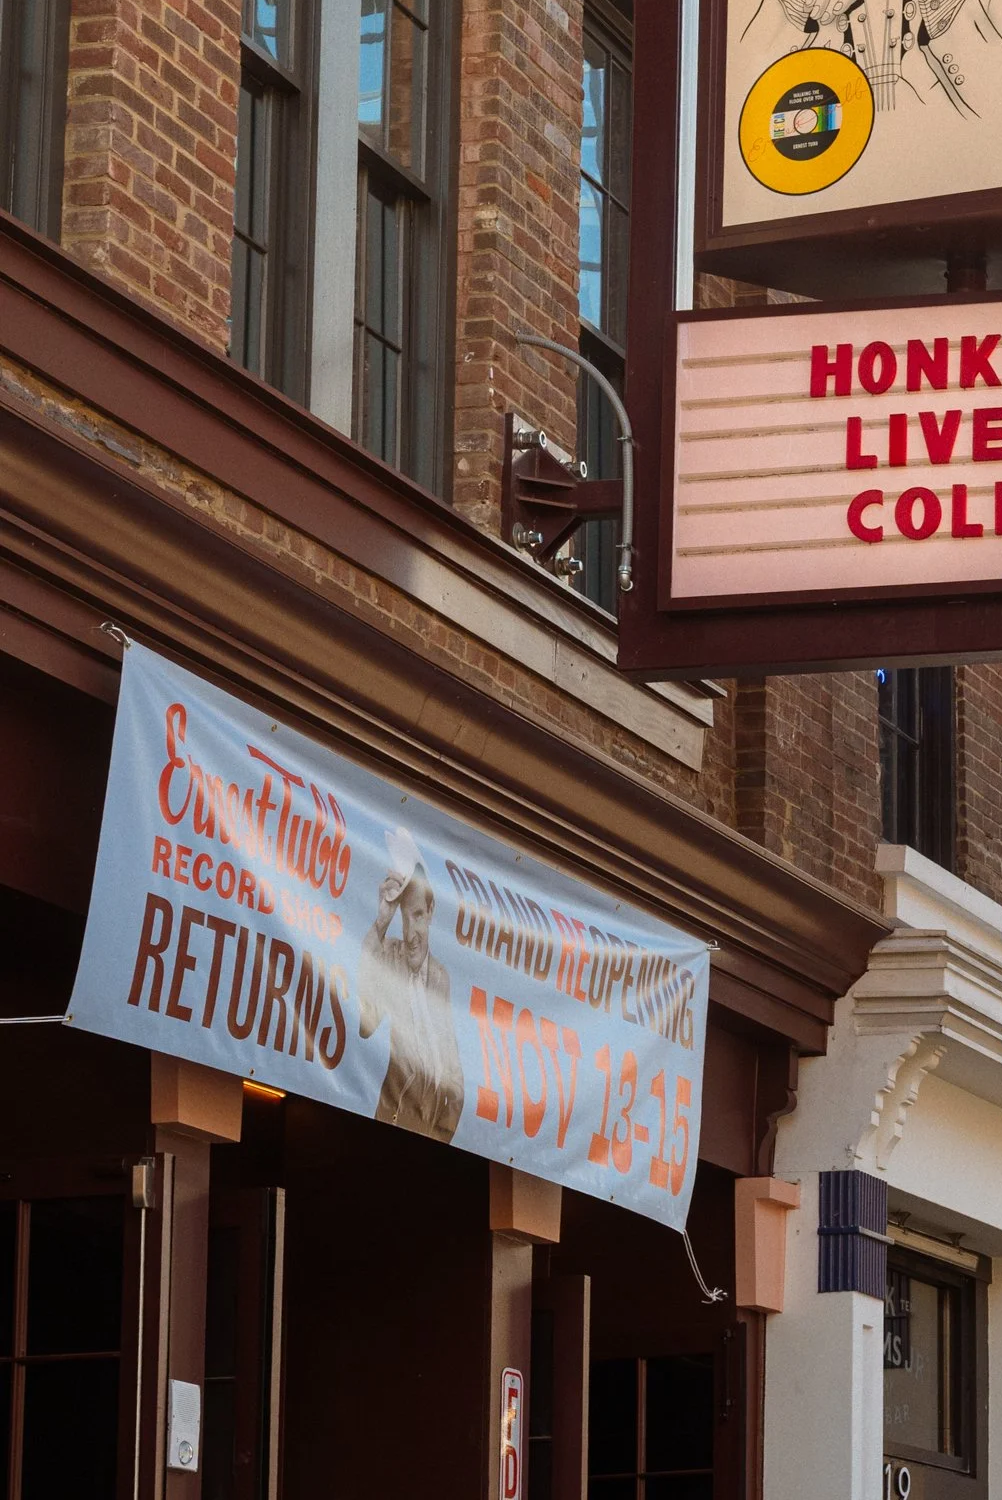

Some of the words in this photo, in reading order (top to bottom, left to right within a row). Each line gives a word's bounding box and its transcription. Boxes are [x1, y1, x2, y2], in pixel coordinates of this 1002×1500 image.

[127, 892, 349, 1071] RETURNS
[152, 835, 275, 915] RECORD
[280, 888, 343, 945] SHOP
[445, 859, 554, 982] GRAND
[550, 908, 695, 1051] REOPENING
[470, 985, 583, 1150] NOV
[587, 1043, 693, 1197] 13-15
